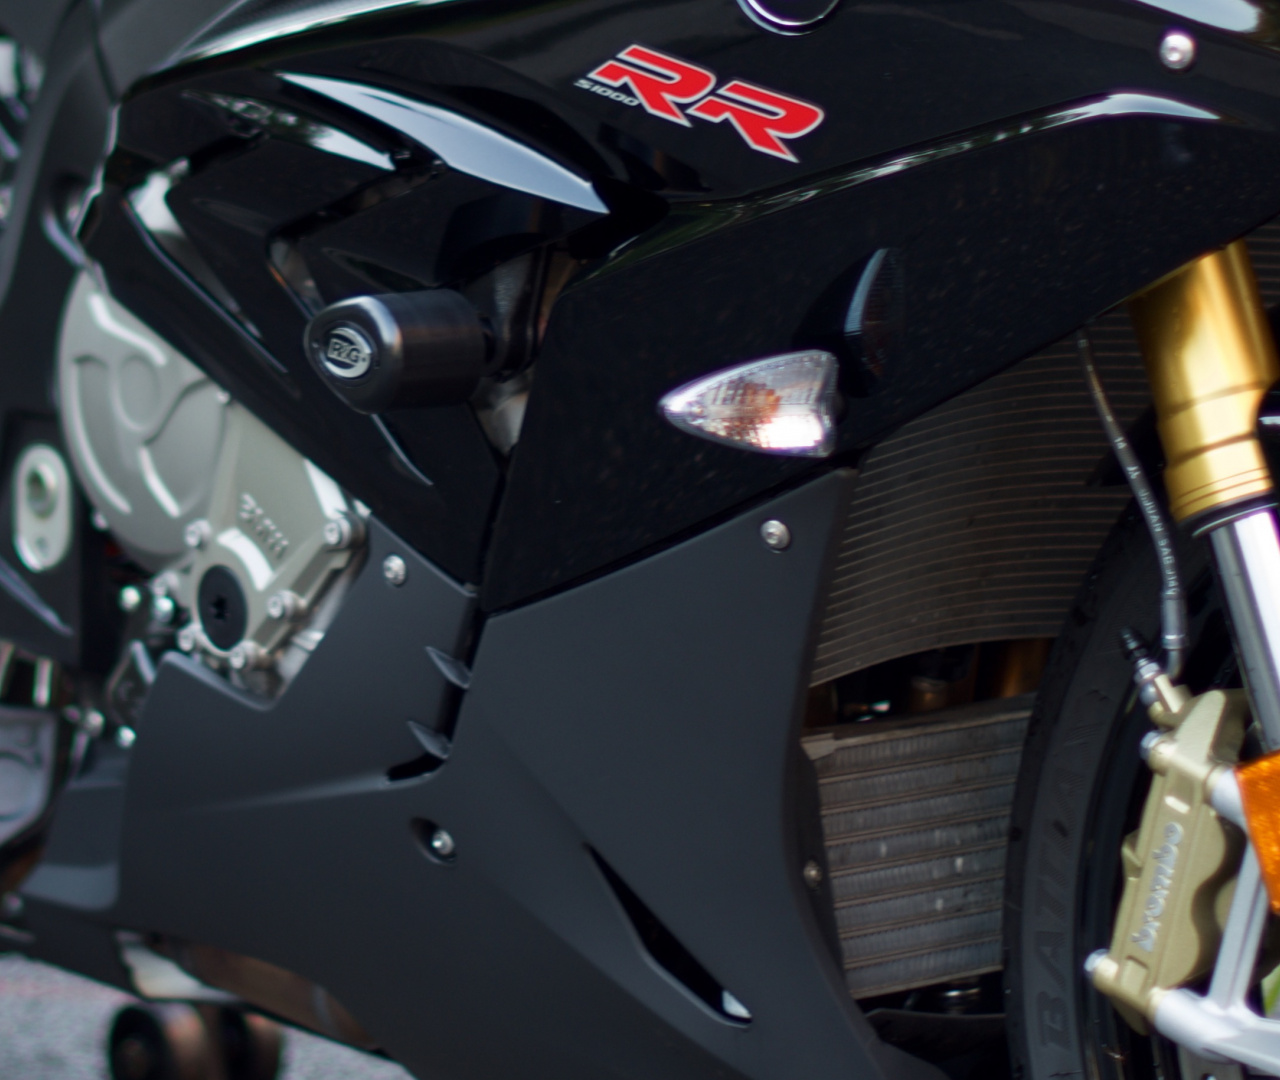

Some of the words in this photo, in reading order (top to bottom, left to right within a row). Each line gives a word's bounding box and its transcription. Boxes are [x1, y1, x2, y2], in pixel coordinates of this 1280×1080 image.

[573, 78, 641, 107] S1000
[586, 44, 825, 163] RR
[1131, 822, 1185, 954] brembo
